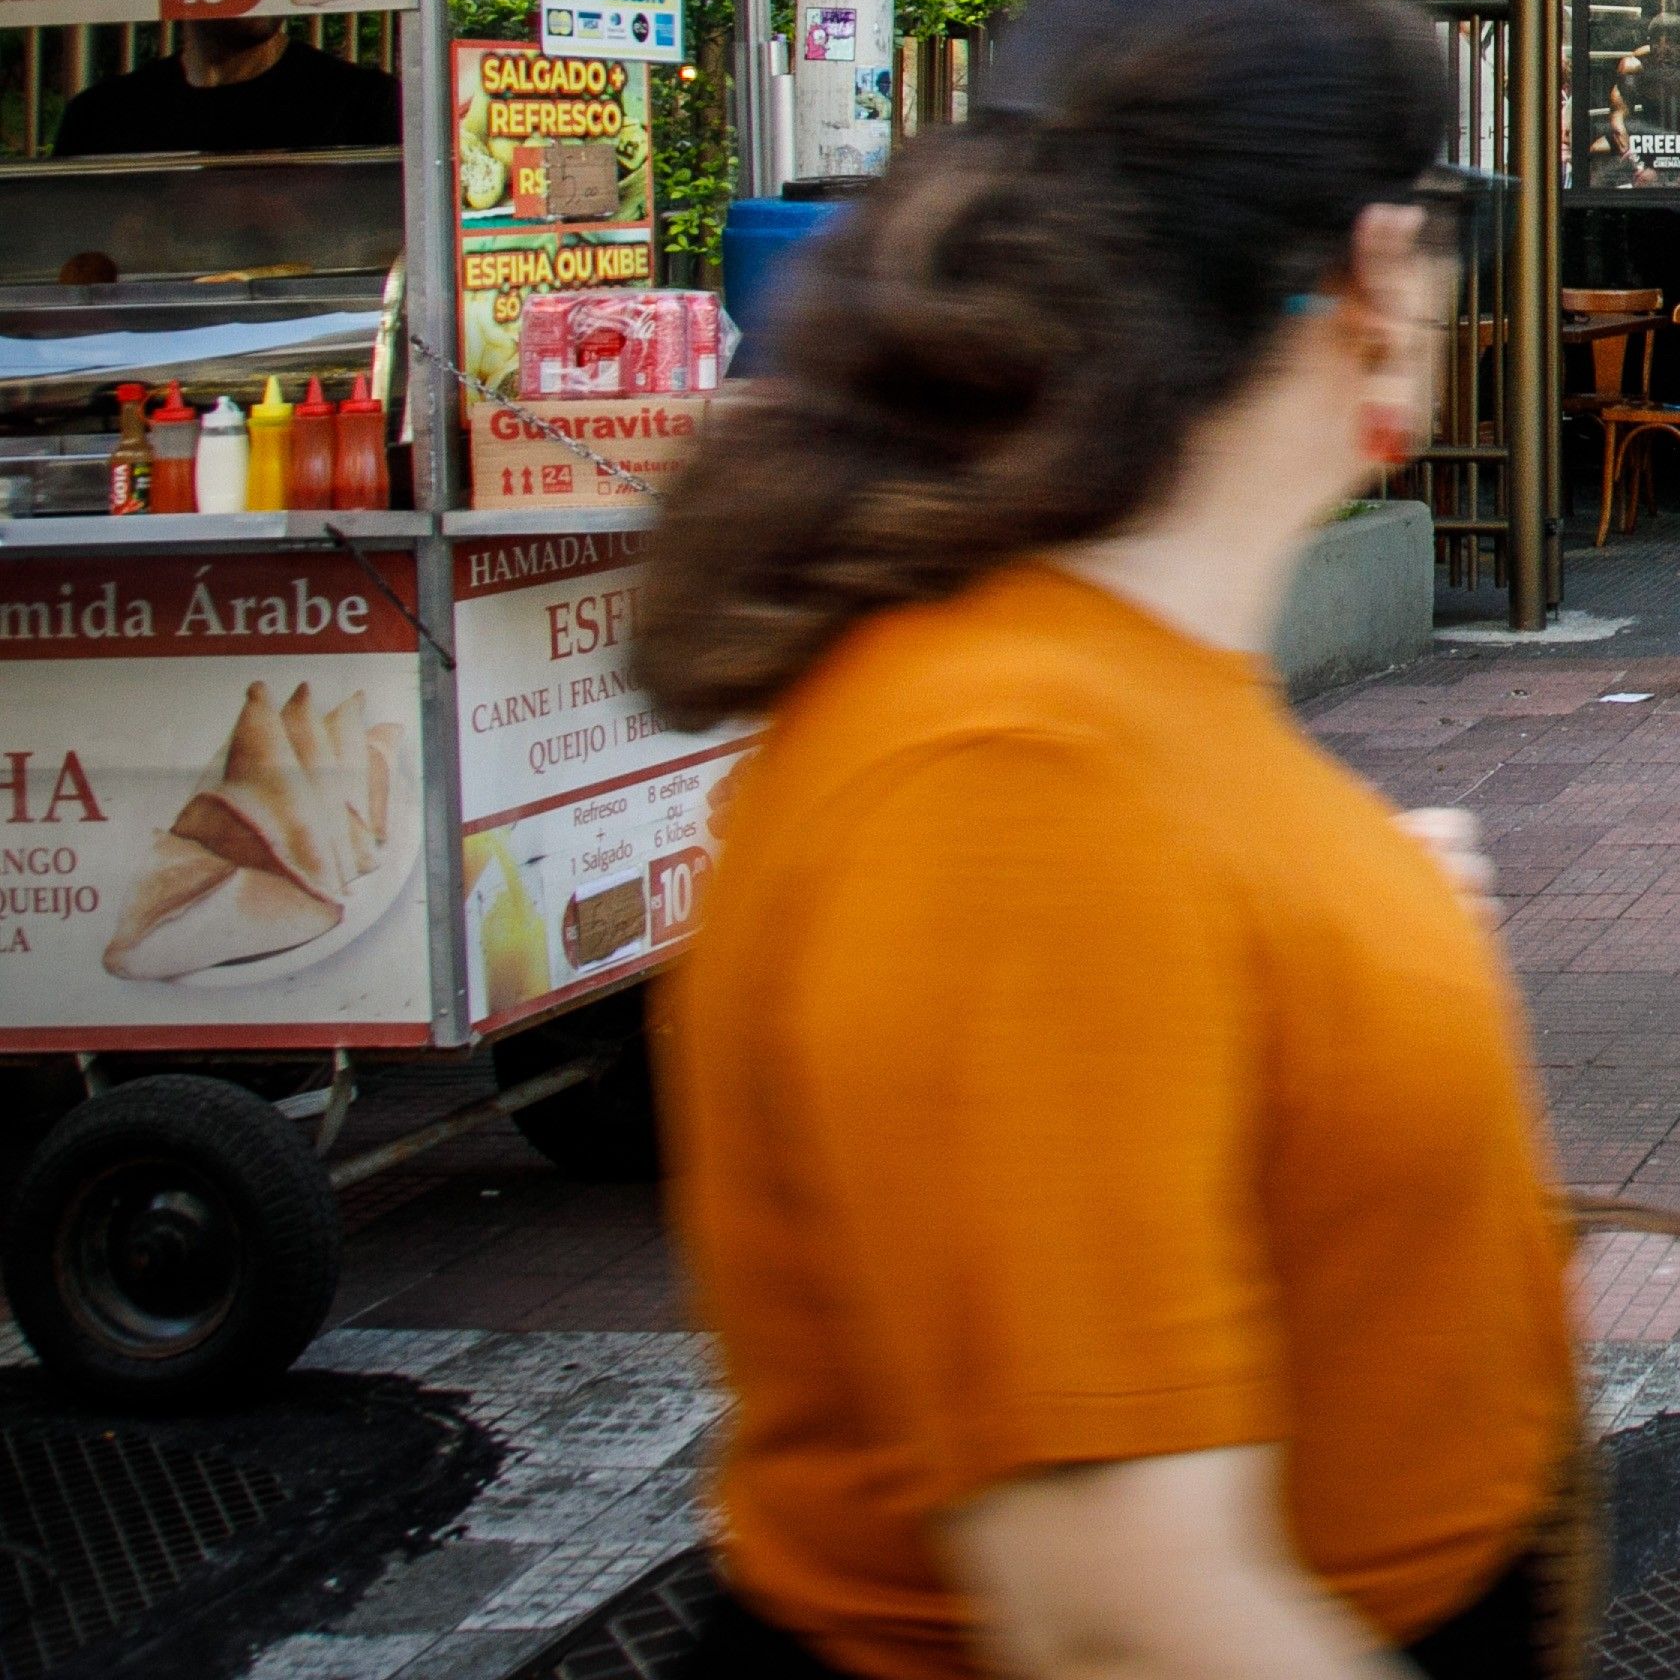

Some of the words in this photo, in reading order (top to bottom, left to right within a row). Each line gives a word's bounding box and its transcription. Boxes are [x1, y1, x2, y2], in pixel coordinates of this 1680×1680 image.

[483, 56, 608, 93] SALGADO
[489, 99, 623, 137] REFRESCO
[465, 251, 555, 288] ESFIHA
[556, 247, 593, 282] OU
[597, 245, 651, 279] KIBE
[489, 407, 696, 442] Guaravita
[468, 535, 599, 588] HAMADA
[0, 581, 155, 641] mida
[175, 564, 371, 636] Árabe
[472, 687, 550, 745] CARNE
[529, 724, 607, 775] QUEIJO
[659, 773, 701, 802] esfihas
[573, 797, 628, 827] Refresco
[654, 831, 663, 849] 6
[666, 820, 698, 844] kibes
[582, 840, 634, 874] Salgado
